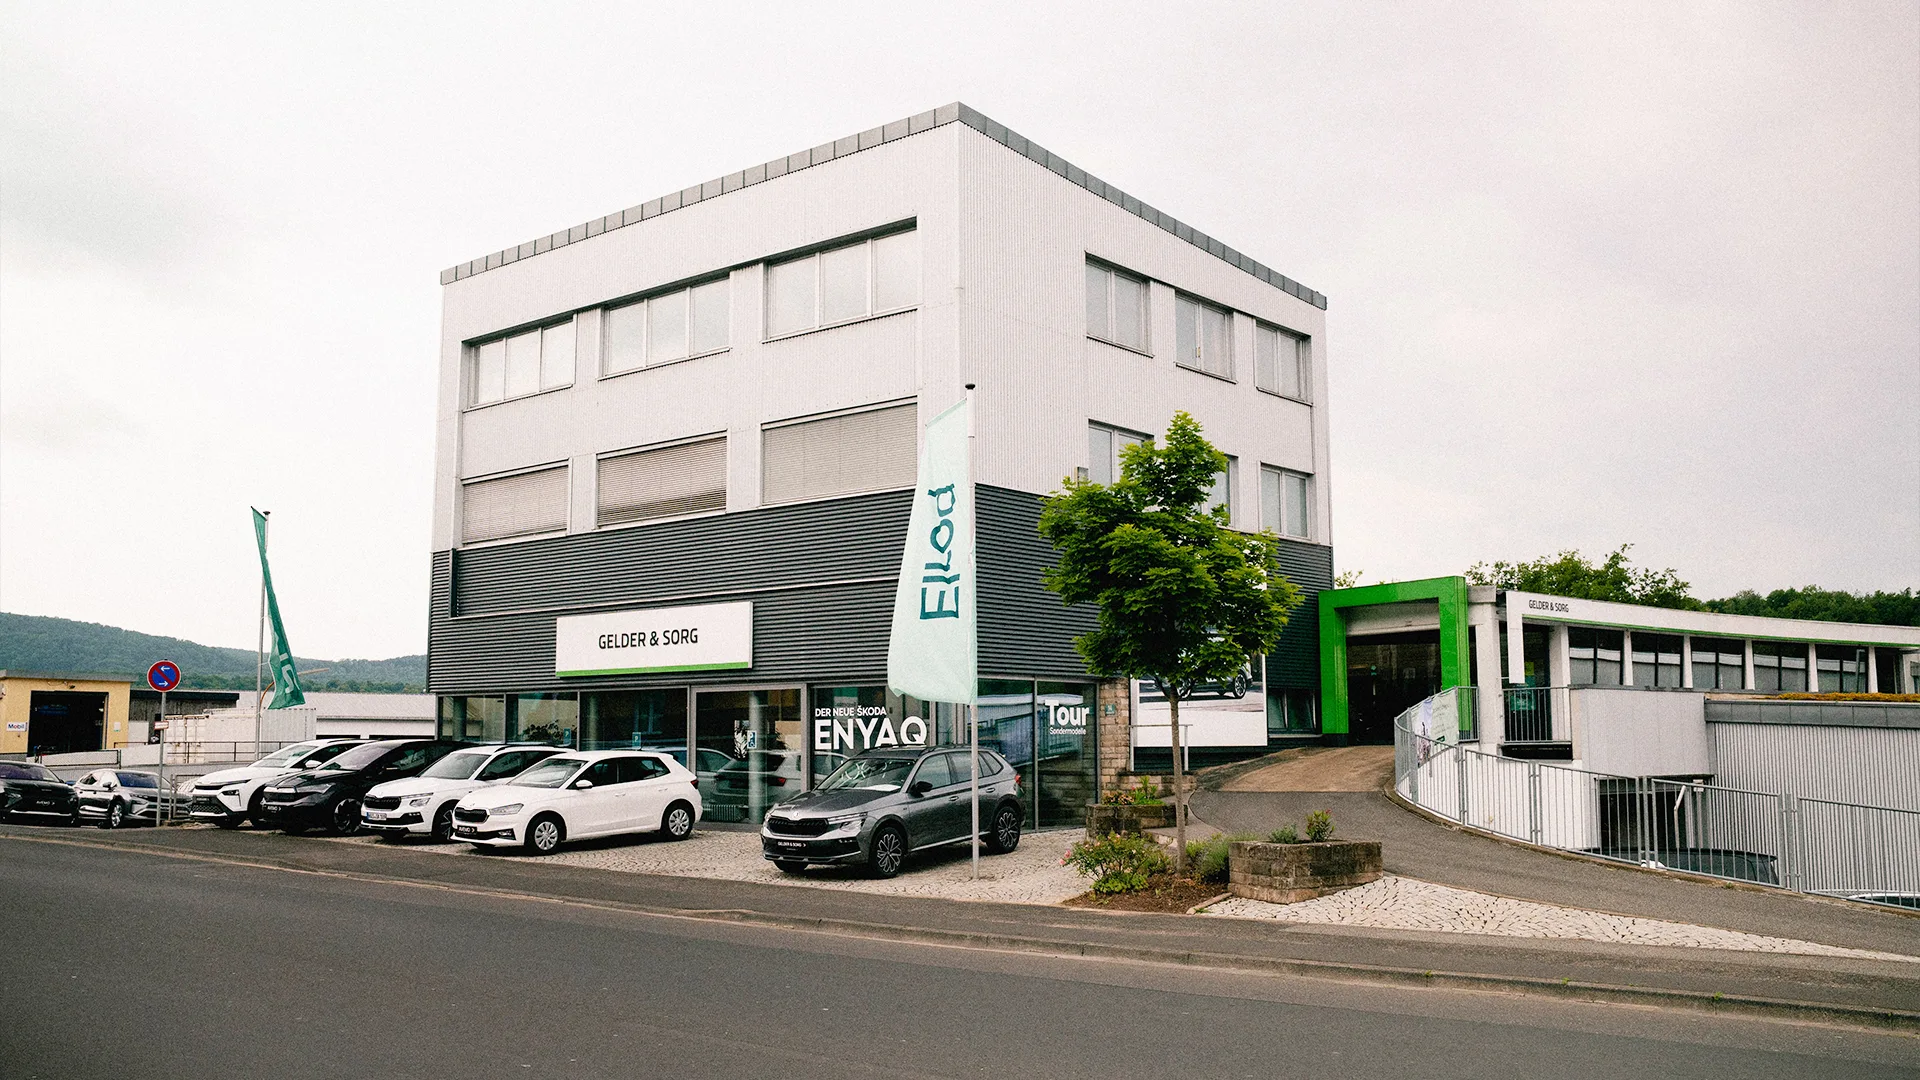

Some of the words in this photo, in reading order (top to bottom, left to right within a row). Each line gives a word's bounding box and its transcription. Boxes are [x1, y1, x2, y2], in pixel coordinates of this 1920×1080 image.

[1528, 599, 1549, 611] GELDER
[1555, 603, 1569, 612] SORG
[598, 631, 646, 649] GELDER
[649, 630, 659, 646] &
[663, 627, 698, 645] SORG
[815, 708, 831, 717] DER
[833, 707, 855, 716] NEUE
[857, 705, 887, 716] ŠKODA
[1045, 699, 1090, 726] Tour
[815, 716, 927, 750] ENYAQ
[1049, 727, 1087, 735] Sondermodelle
